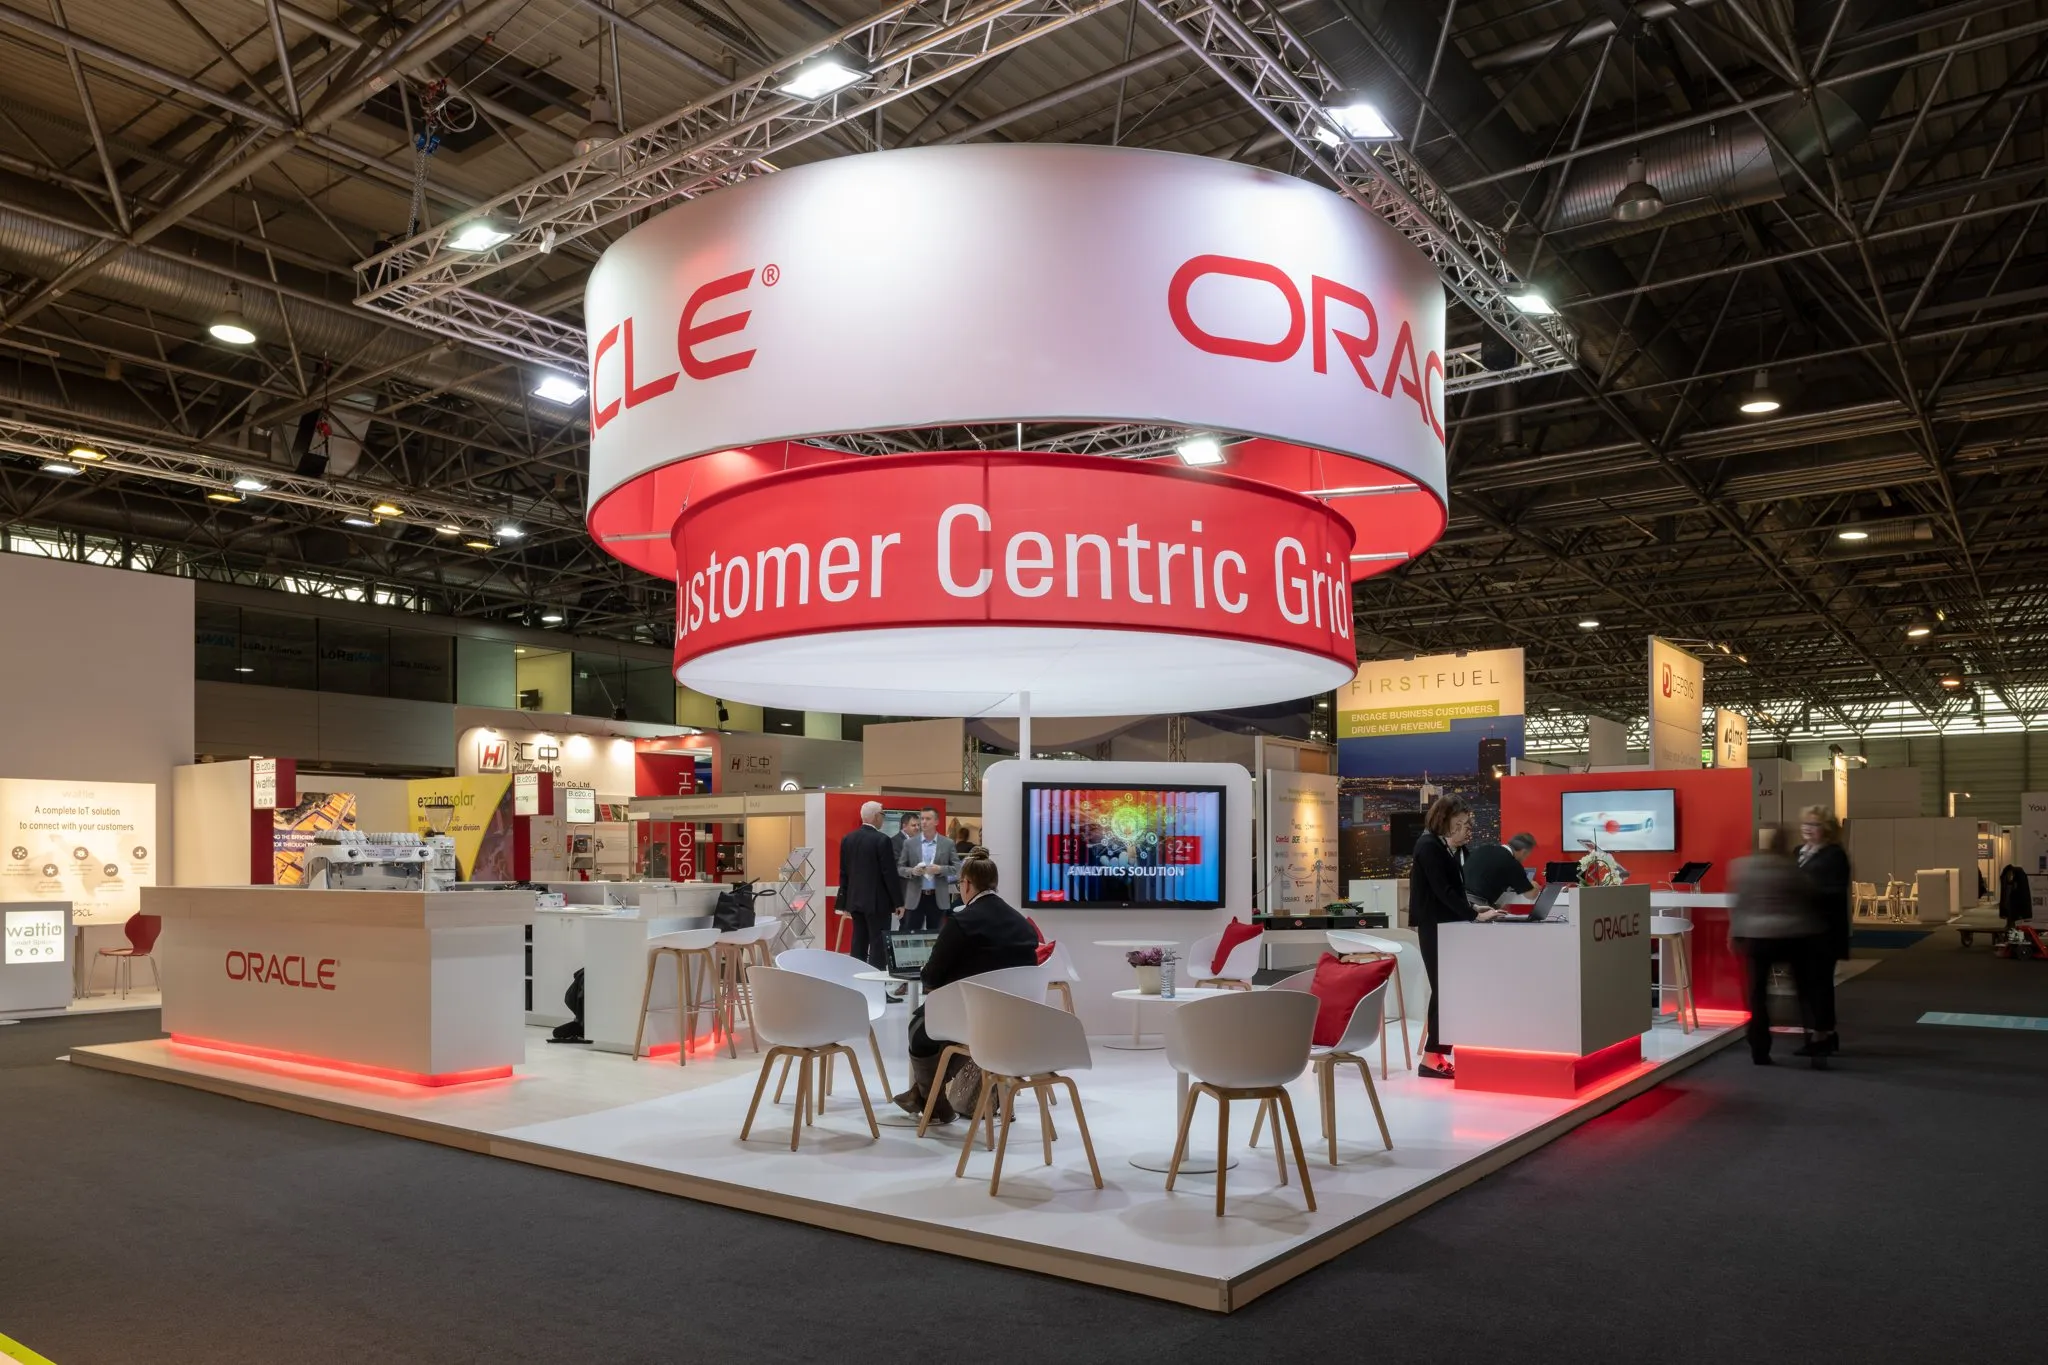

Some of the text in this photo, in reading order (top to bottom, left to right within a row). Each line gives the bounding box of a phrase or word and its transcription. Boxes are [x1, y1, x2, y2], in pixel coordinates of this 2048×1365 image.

[675, 504, 1350, 648] ustomer Centric Grid
[1351, 669, 1500, 695] FIRSTFUEL
[1351, 704, 1496, 722] ENGAGE BUSINESS CUSTOMERS.
[1351, 720, 1445, 734] DRIVE NEW REVENUE.
[34, 805, 121, 817] A complete IoT solution
[19, 821, 134, 833] to connect with your customers
[1066, 866, 1184, 877] ANALYTICS SOLUTION
[1593, 912, 1640, 942] ORACLE
